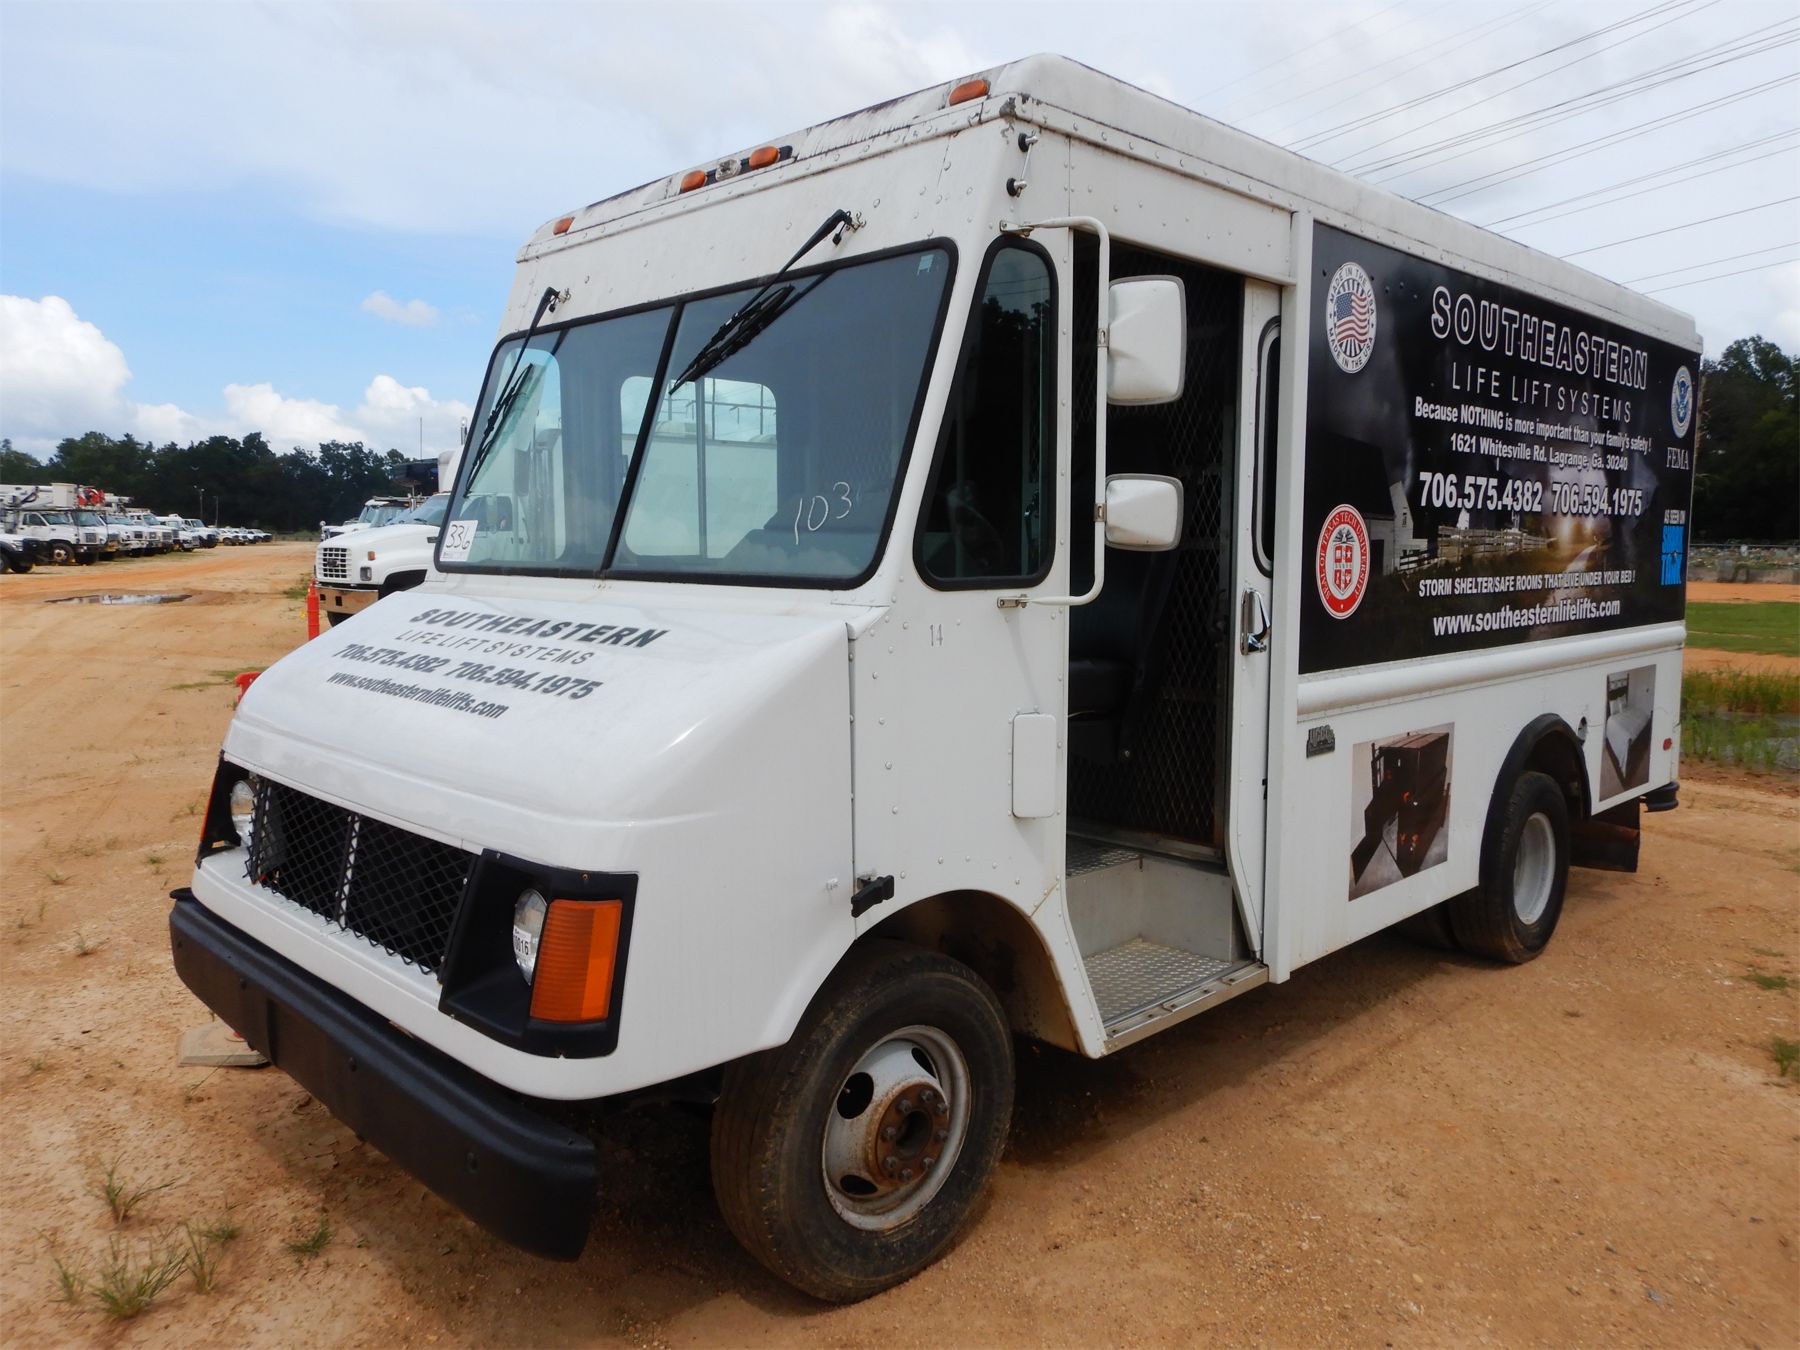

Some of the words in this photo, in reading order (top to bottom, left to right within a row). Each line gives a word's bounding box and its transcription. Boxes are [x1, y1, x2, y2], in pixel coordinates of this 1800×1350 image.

[1431, 285, 1648, 390] SOUTHEASTERN
[1452, 362, 1501, 397] LIFE
[1415, 395, 1458, 422] Because
[1461, 404, 1504, 430] NOTHING
[1505, 412, 1513, 431] is
[1514, 418, 1535, 434] more
[1536, 418, 1571, 441] important
[1573, 425, 1589, 443] than
[1590, 431, 1605, 448] your
[1606, 430, 1630, 452] family's
[1450, 432, 1477, 454] 1621
[1479, 436, 1531, 460] Whitesville
[1533, 445, 1547, 462] Rd.
[1549, 446, 1590, 472] Lagrange,
[1591, 453, 1605, 468] Ga.
[1606, 454, 1628, 472] 30240
[1666, 447, 1689, 470] FEMA
[794, 481, 852, 546] 103
[1420, 471, 1543, 513] 706.575.4382
[1552, 482, 1643, 517] 706.594.1975
[446, 524, 471, 550] 336
[1322, 514, 1340, 546] TEXAS
[1340, 511, 1357, 528] TECH
[1419, 578, 1452, 597] STORM
[1516, 574, 1543, 591] ROOMS
[1544, 573, 1562, 588] THAT
[1563, 572, 1579, 588] LIVE
[1580, 571, 1602, 586] UNDER
[1604, 571, 1619, 584] YOUR
[409, 608, 669, 649] SOUTHEASTERN
[1433, 597, 1620, 636] www.southeasternlifelifts.com
[395, 630, 444, 645] LIFE
[332, 643, 451, 673] 706.575.4382
[444, 661, 604, 700] 706.594.1975
[326, 671, 510, 719] www.southeasternlifelifts.com
